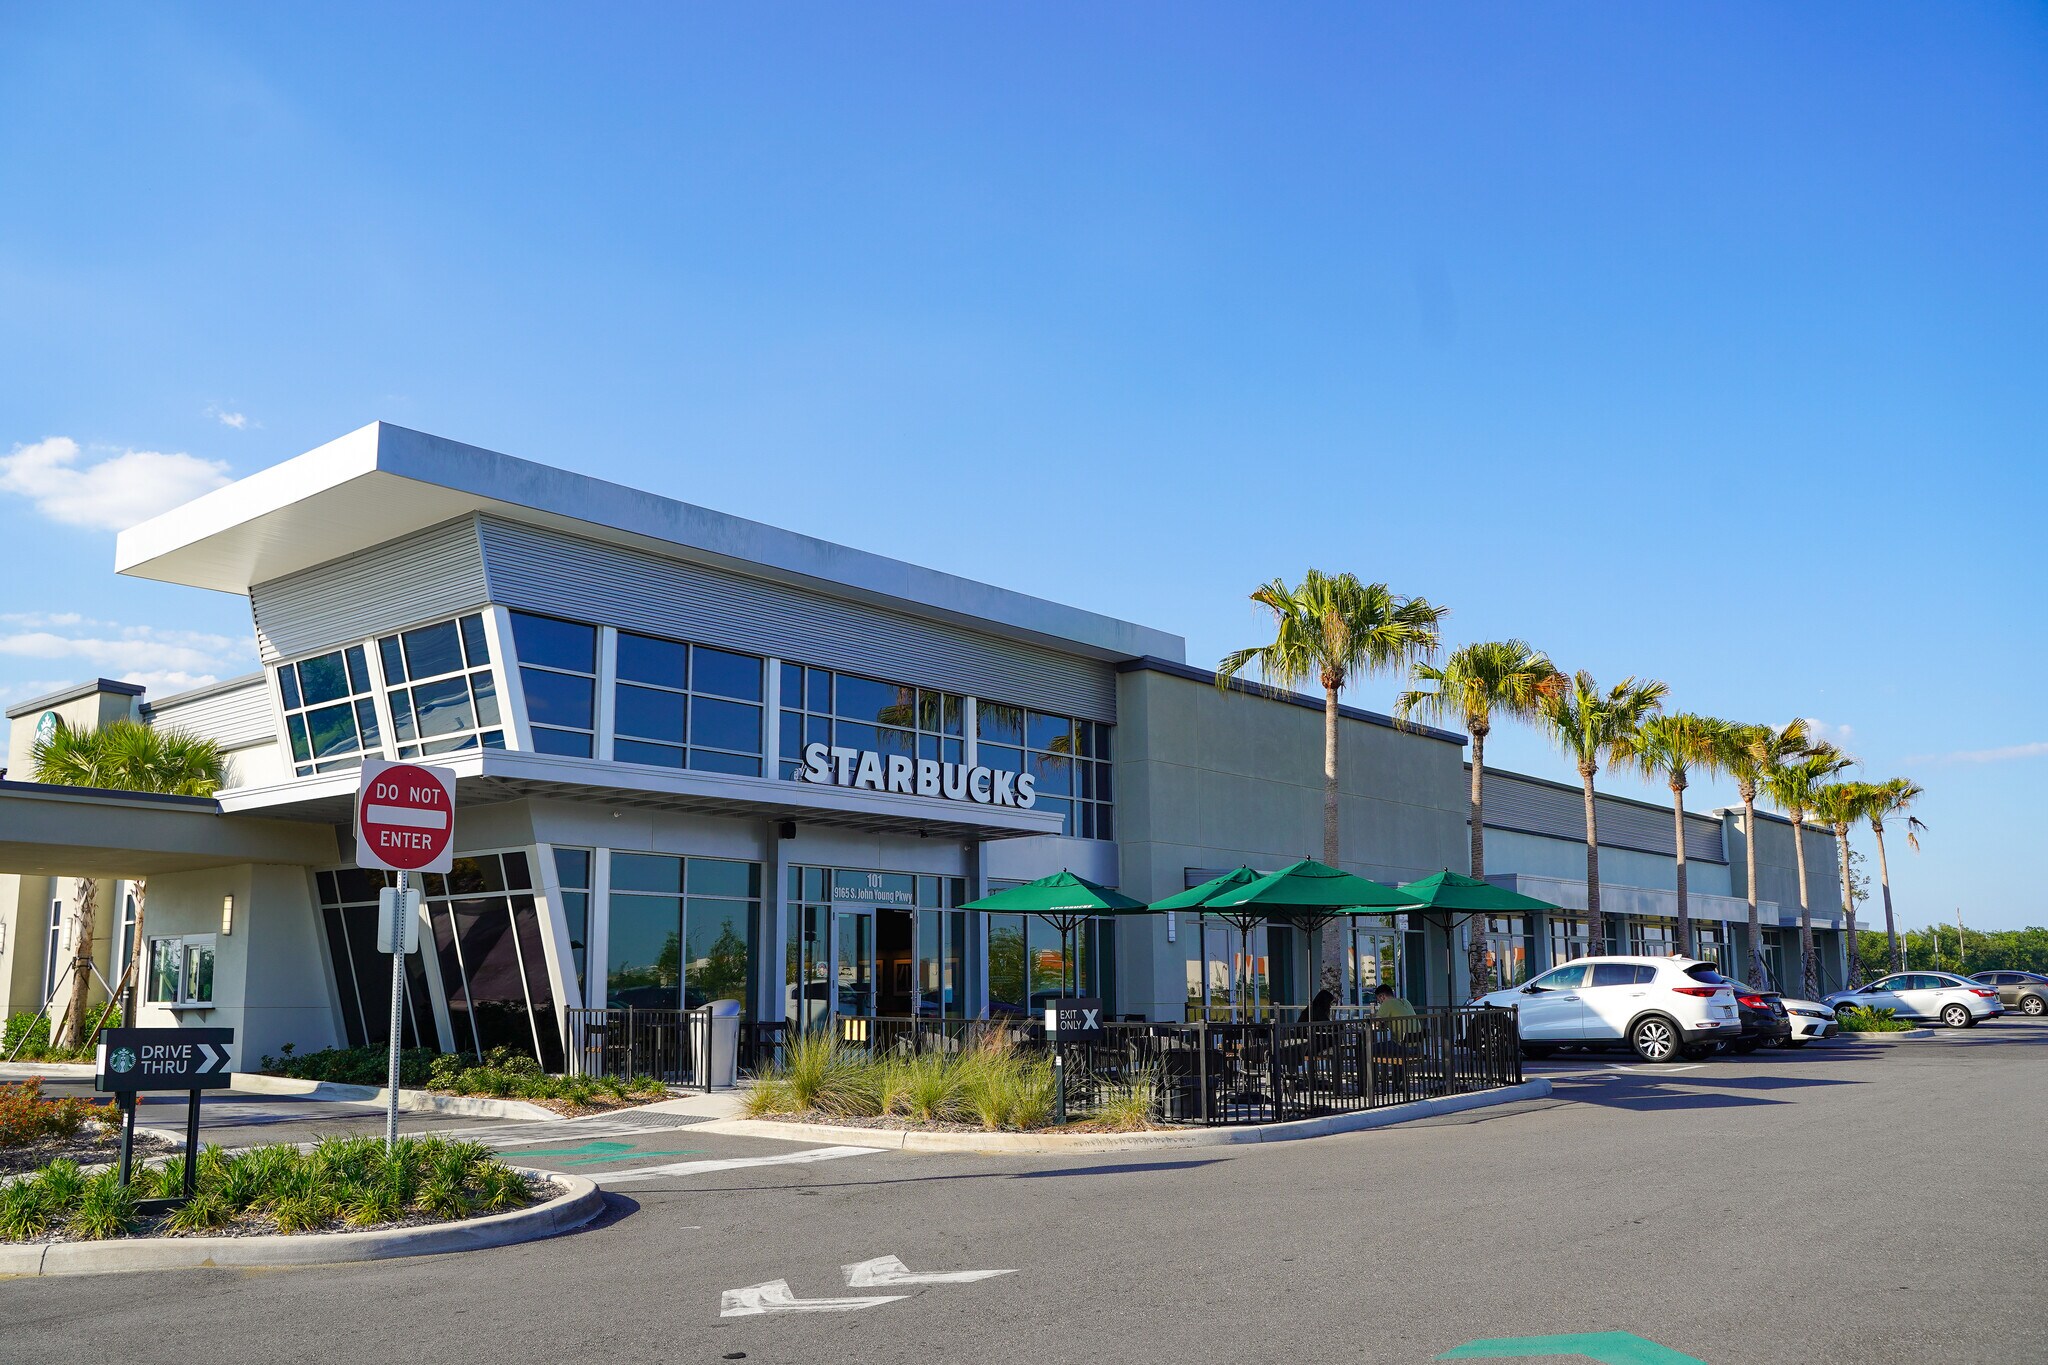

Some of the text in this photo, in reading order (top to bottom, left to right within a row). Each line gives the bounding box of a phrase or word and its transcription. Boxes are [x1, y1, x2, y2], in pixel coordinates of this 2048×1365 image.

[803, 742, 1036, 809] STARBUCKS
[376, 783, 441, 804] DO NOT
[380, 830, 432, 850] ENTER
[867, 873, 883, 888] 101
[834, 887, 913, 904] 9165 S. John Young Pkwy
[1060, 1010, 1077, 1019] EXIT
[1060, 1020, 1081, 1030] ONLY
[141, 1045, 192, 1059] DRIVE
[141, 1060, 188, 1075] THRU
